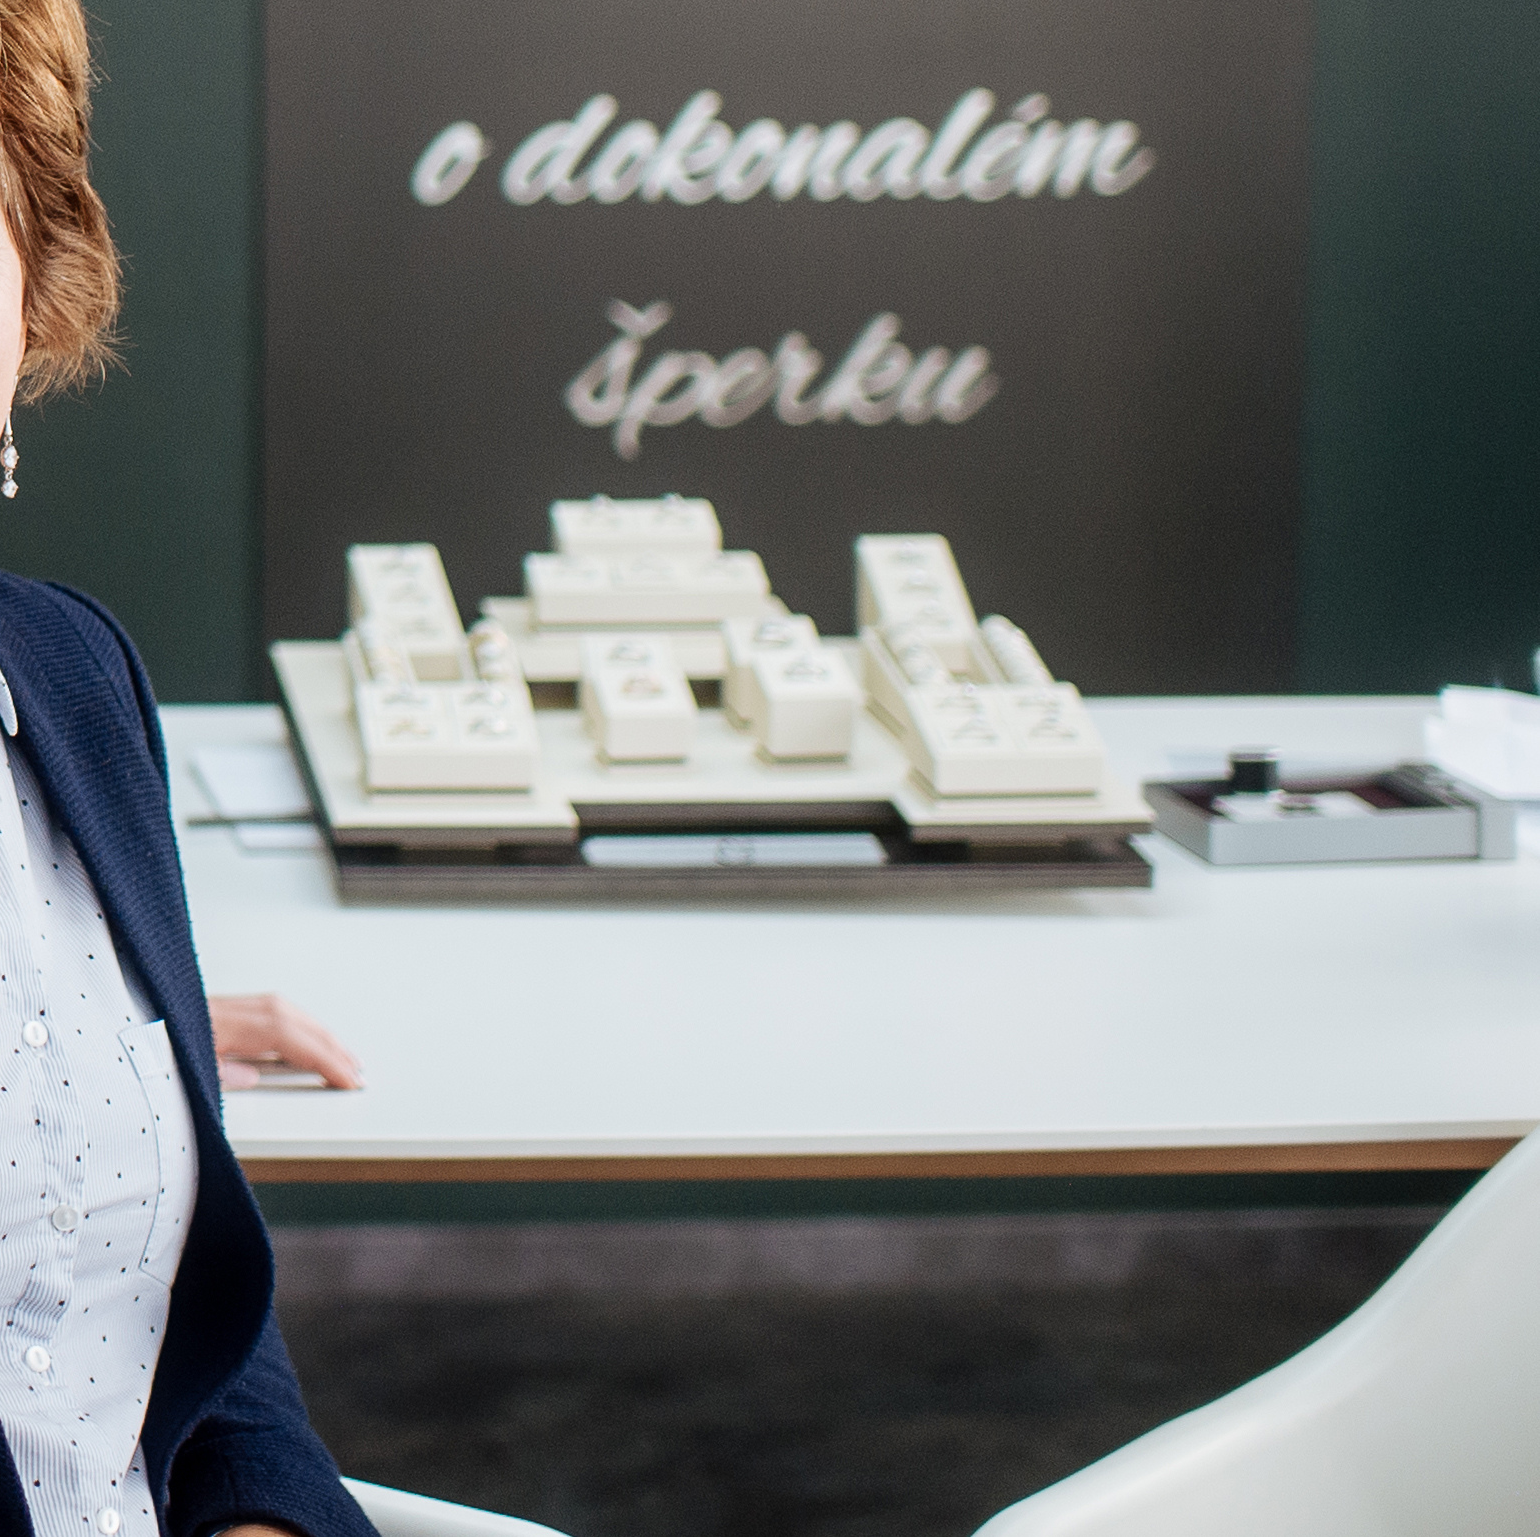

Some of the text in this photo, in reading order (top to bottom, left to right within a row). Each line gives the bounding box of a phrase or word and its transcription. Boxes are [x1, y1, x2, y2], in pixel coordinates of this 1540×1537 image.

[411, 87, 1156, 206] o dokonalém
[565, 298, 999, 460] šperku
